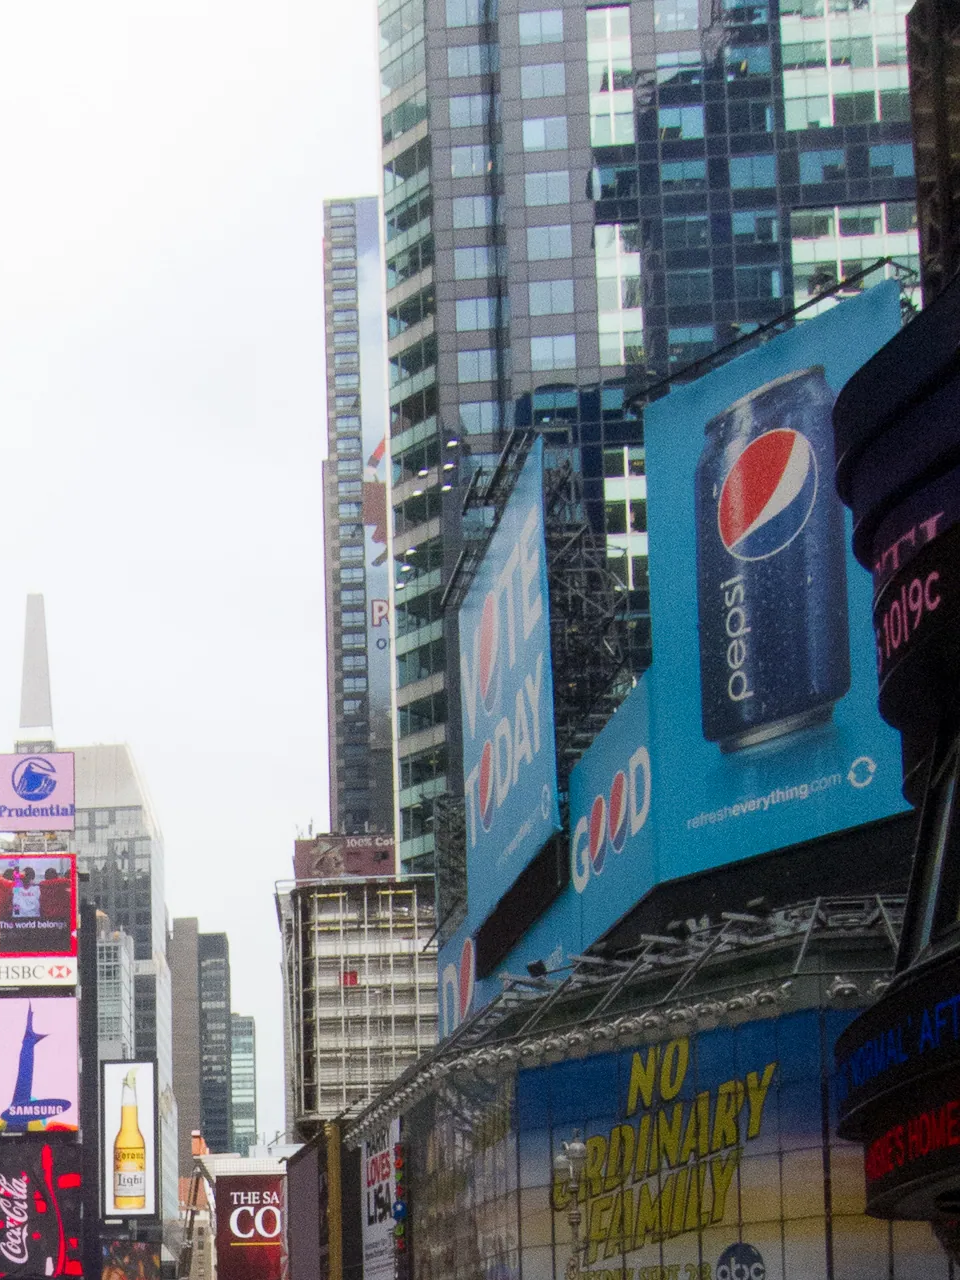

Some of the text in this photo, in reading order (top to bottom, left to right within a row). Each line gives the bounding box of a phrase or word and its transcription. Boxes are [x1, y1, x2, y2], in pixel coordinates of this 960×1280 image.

[720, 574, 754, 702] pepsi
[464, 650, 543, 848] TODAY
[572, 746, 651, 894] GOOD
[687, 773, 842, 829] refresheverything.com
[9, 1105, 63, 1116] SAMSUNG
[627, 1037, 689, 1118] NO
[230, 1192, 260, 1205] THE
[367, 1151, 391, 1188] LOVES
[583, 1147, 743, 1267] FAMILY
